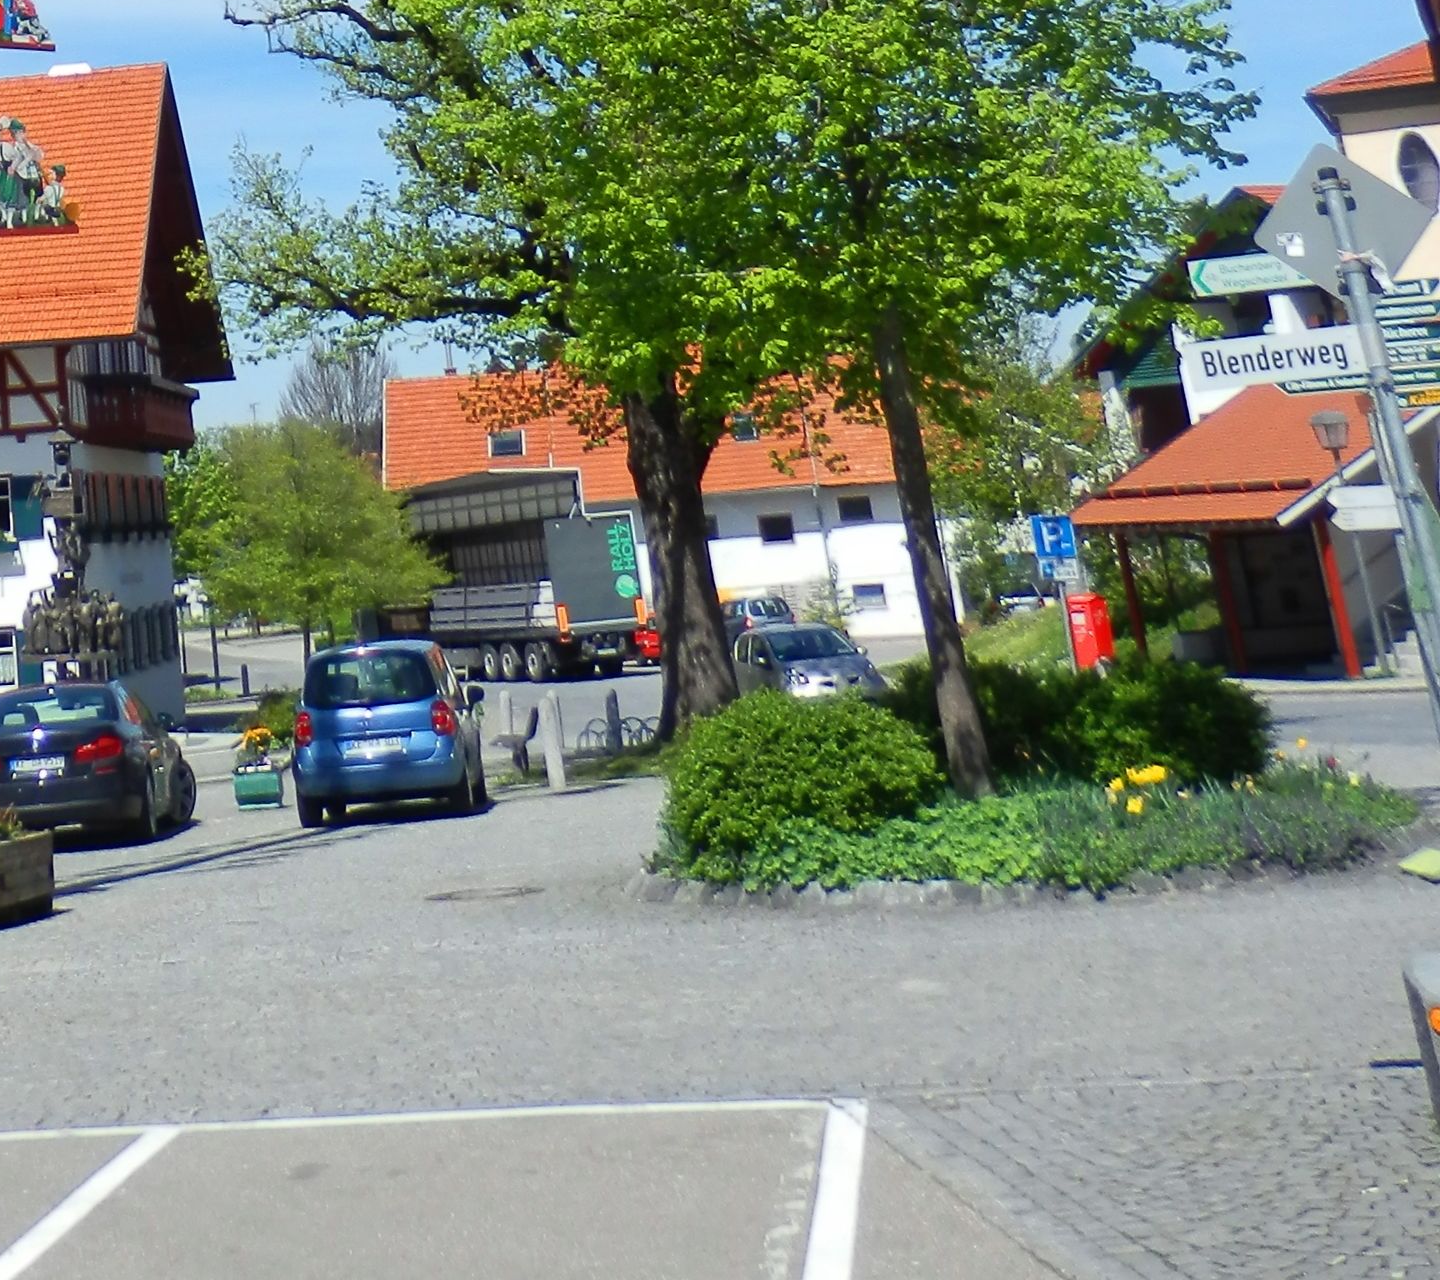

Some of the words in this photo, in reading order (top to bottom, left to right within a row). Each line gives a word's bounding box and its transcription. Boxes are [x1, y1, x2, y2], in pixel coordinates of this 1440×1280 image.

[1201, 343, 1349, 378] Blenderweg
[606, 523, 624, 572] RALL
[619, 522, 636, 570] HOLZ
